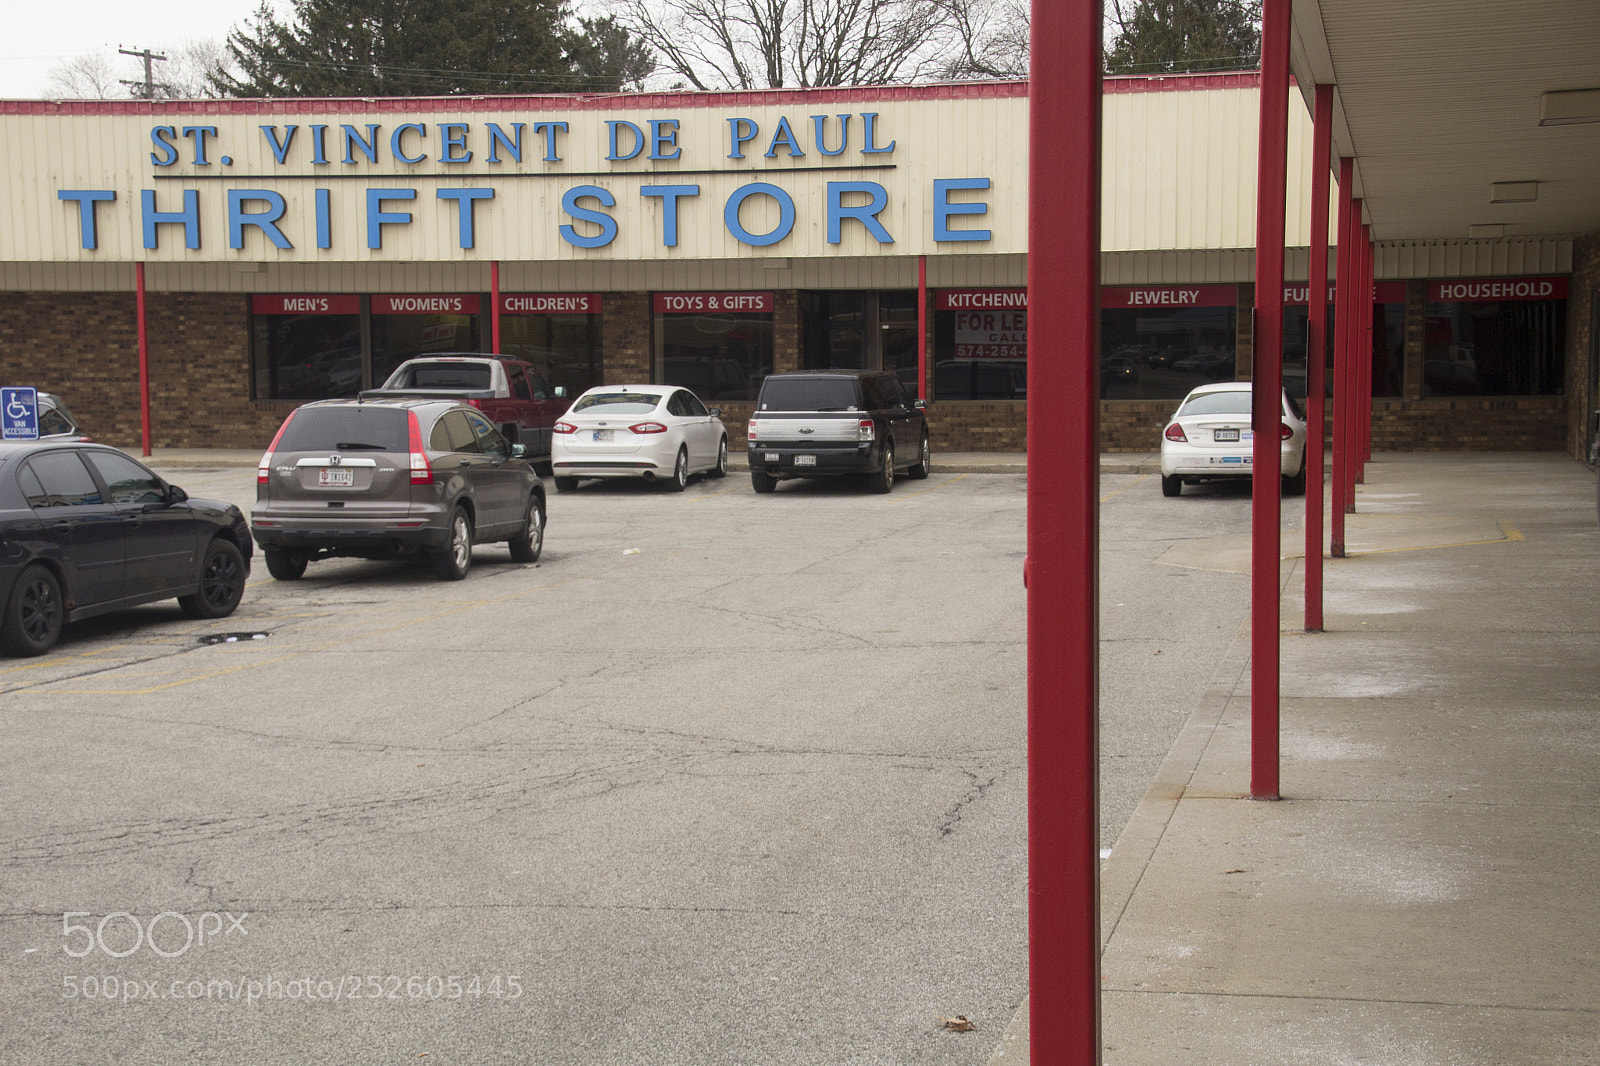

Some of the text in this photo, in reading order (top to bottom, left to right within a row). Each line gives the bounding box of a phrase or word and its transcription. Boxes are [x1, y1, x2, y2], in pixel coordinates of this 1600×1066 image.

[150, 112, 897, 167] ST. VINCENT DE PAUL
[57, 177, 993, 250] THRIFT STORE
[1127, 290, 1200, 305] JEWELRY
[1439, 282, 1553, 300] HOUSEHOLD
[283, 298, 329, 312] MEN'S
[390, 298, 462, 311] WOMEN'S
[504, 297, 589, 311] CHILDREN'S
[664, 296, 764, 310] TOYS & GIFTS
[957, 313, 1028, 331] FOR LE
[988, 333, 1028, 342] CALL
[4, 427, 37, 435] ACCESSIBLE
